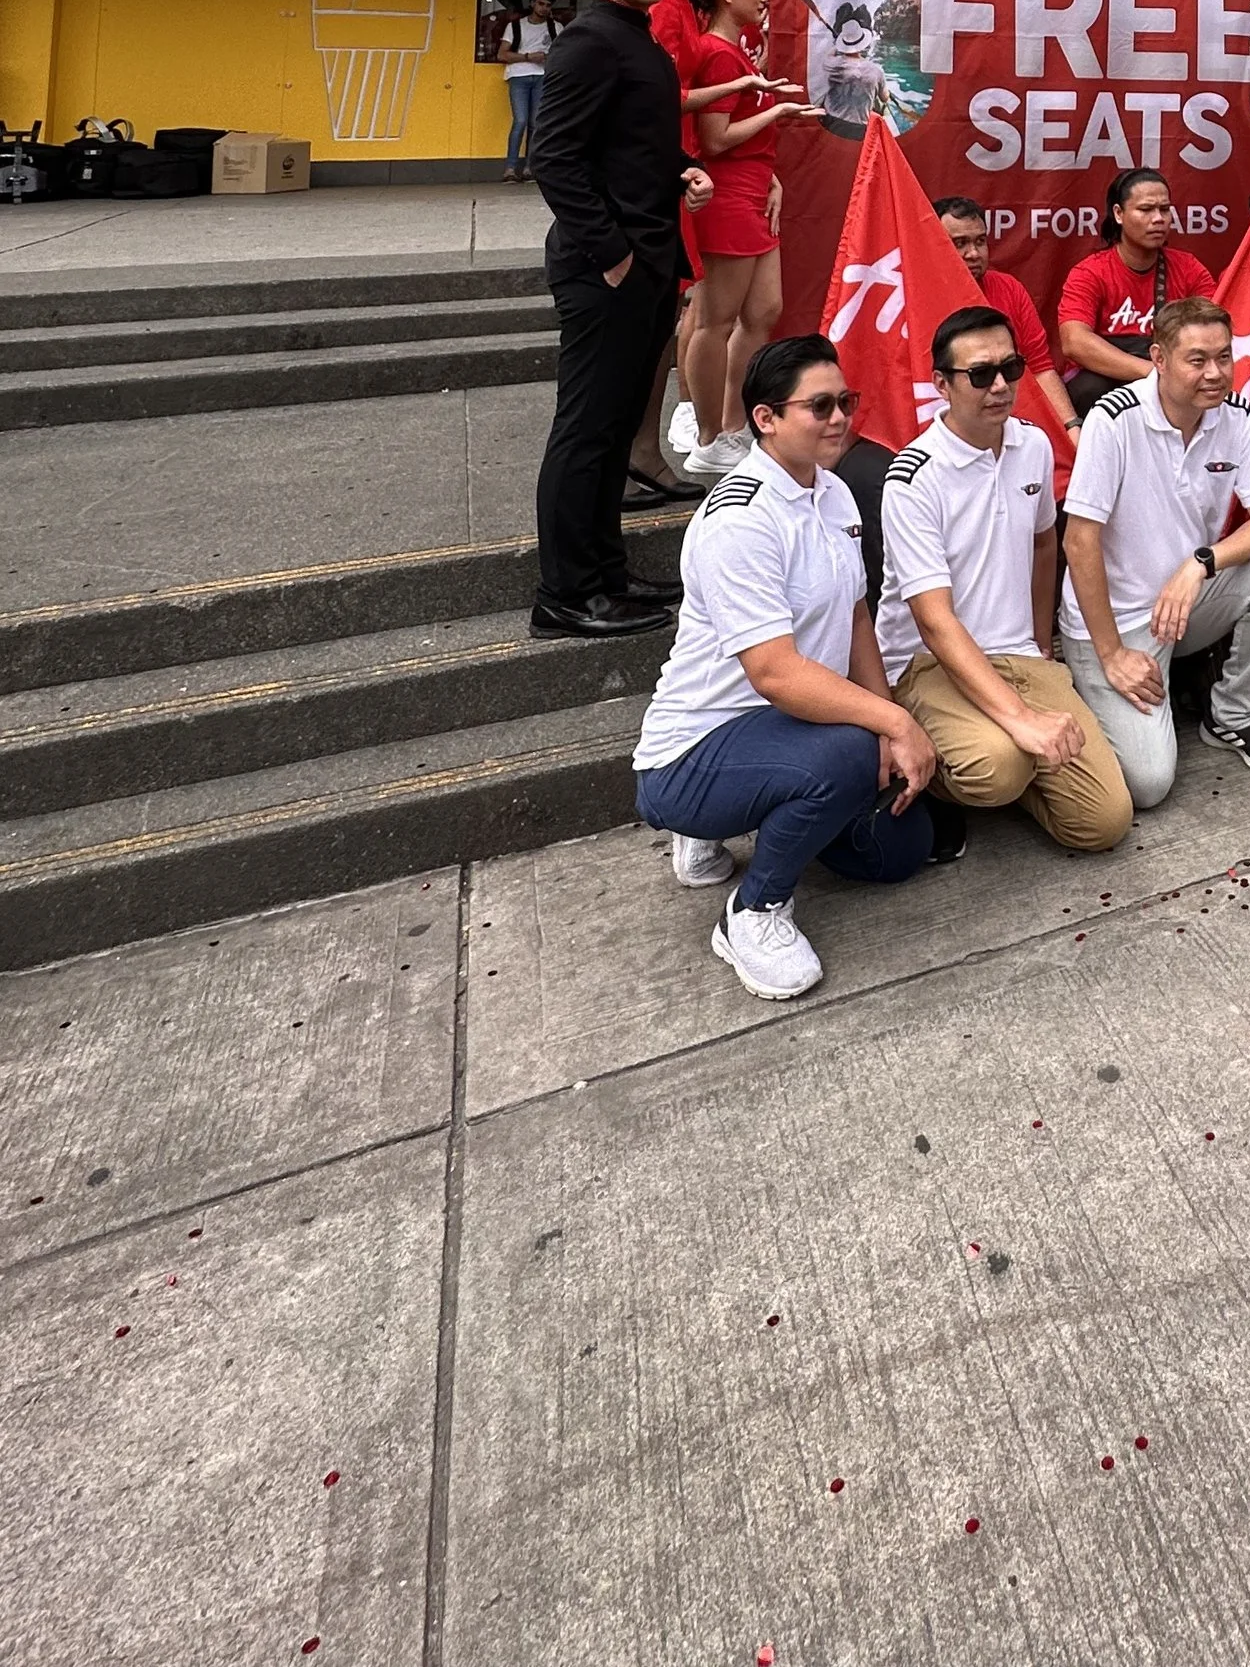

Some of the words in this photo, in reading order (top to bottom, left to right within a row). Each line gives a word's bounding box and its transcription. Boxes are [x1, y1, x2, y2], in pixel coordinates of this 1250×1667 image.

[965, 90, 1233, 171] SEATS
[1031, 207, 1099, 238] FOR
[1168, 204, 1229, 234] ABS
[1108, 296, 1155, 333] AirA
